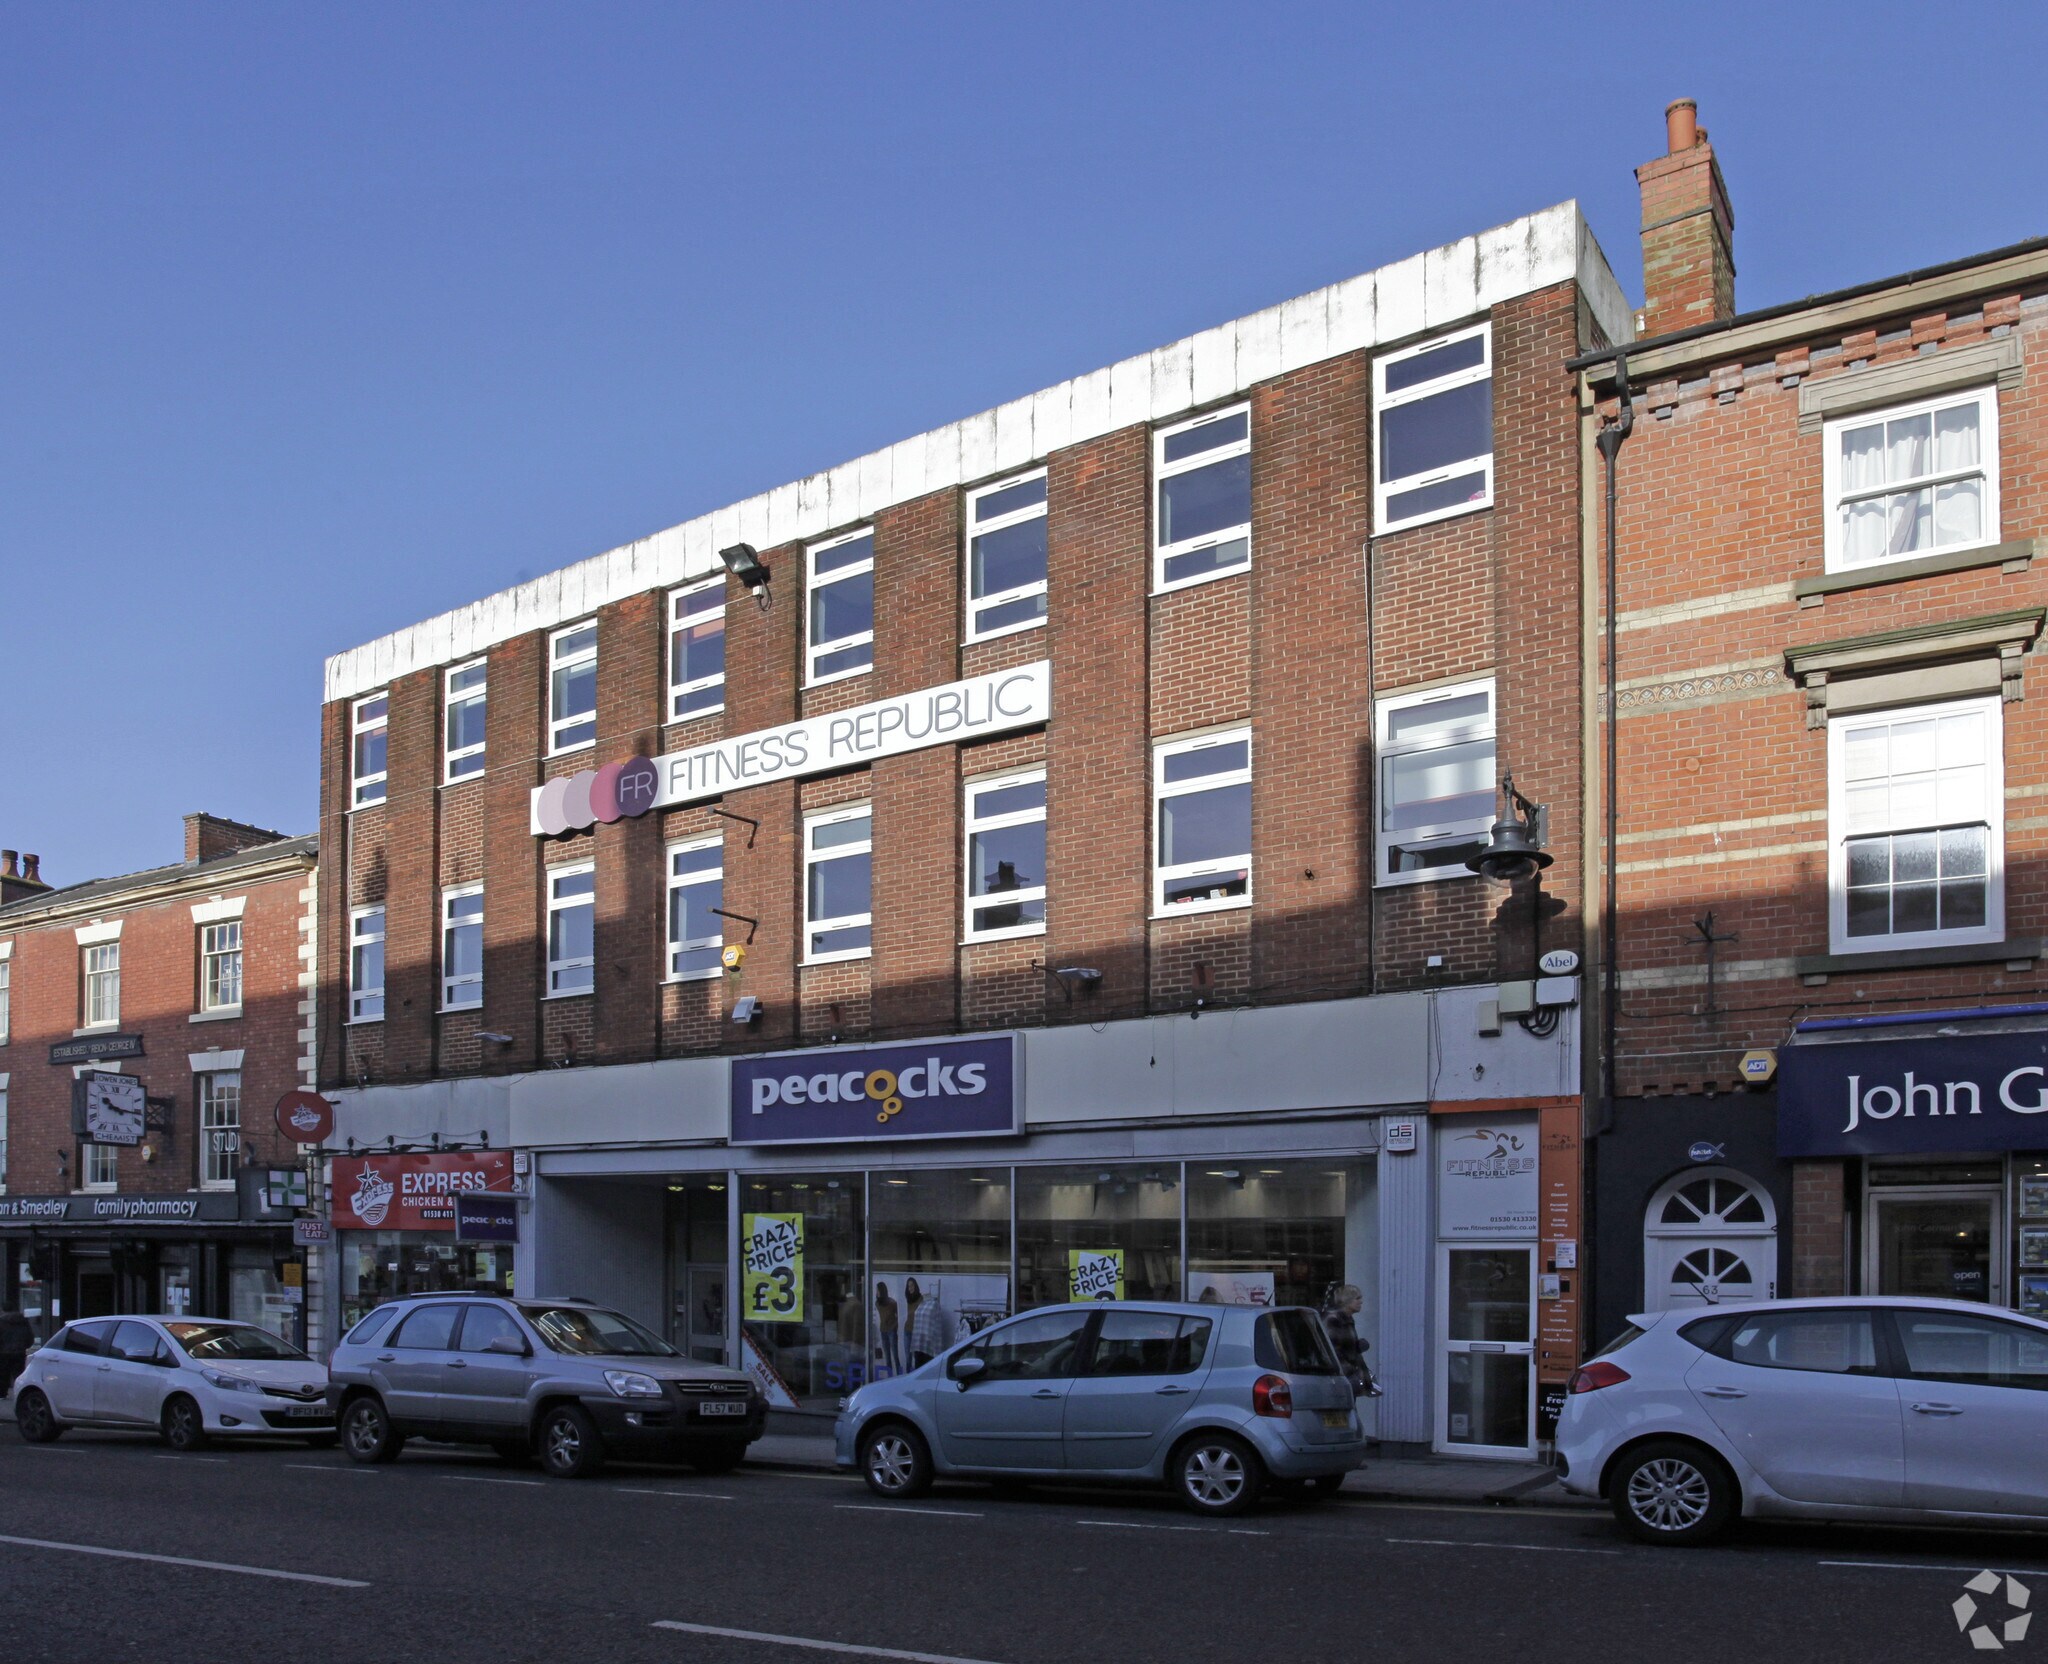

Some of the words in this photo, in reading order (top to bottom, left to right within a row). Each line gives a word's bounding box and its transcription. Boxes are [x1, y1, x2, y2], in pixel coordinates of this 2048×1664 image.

[669, 729, 809, 796] FITNESS
[828, 673, 1035, 759] REPUBLIC
[619, 769, 654, 802] FR
[1544, 955, 1573, 969] Abel
[1746, 1061, 1769, 1071] ADT
[118, 1076, 137, 1086] JONES
[751, 1057, 987, 1123] peacocks
[1840, 1071, 1983, 1134] John
[95, 1133, 136, 1143] CHEMIST
[1446, 1157, 1535, 1172] FITNESS
[1465, 1169, 1515, 1177] REPUBLIC
[401, 1171, 486, 1195] EXPRESS
[11, 1202, 18, 1215] &
[20, 1199, 68, 1218] Smedley
[93, 1198, 198, 1218] familypharmacy
[401, 1196, 444, 1208] CHICKEN
[446, 1196, 454, 1207] &
[299, 1222, 323, 1231] JUST
[462, 1216, 514, 1226] peacocks
[1452, 1224, 1537, 1232] www.fitnessrepublic.co.uk
[305, 1230, 322, 1239] EAT
[742, 1216, 797, 1254] CRAZY
[744, 1236, 805, 1275] PRICES
[1069, 1253, 1118, 1282] CRAZY
[1071, 1268, 1125, 1298] PRICES
[1953, 1271, 1981, 1281] open
[752, 1266, 796, 1312] £3
[1702, 1284, 1719, 1295] 63
[755, 1362, 775, 1387] SALE
[703, 1403, 726, 1414] FL57
